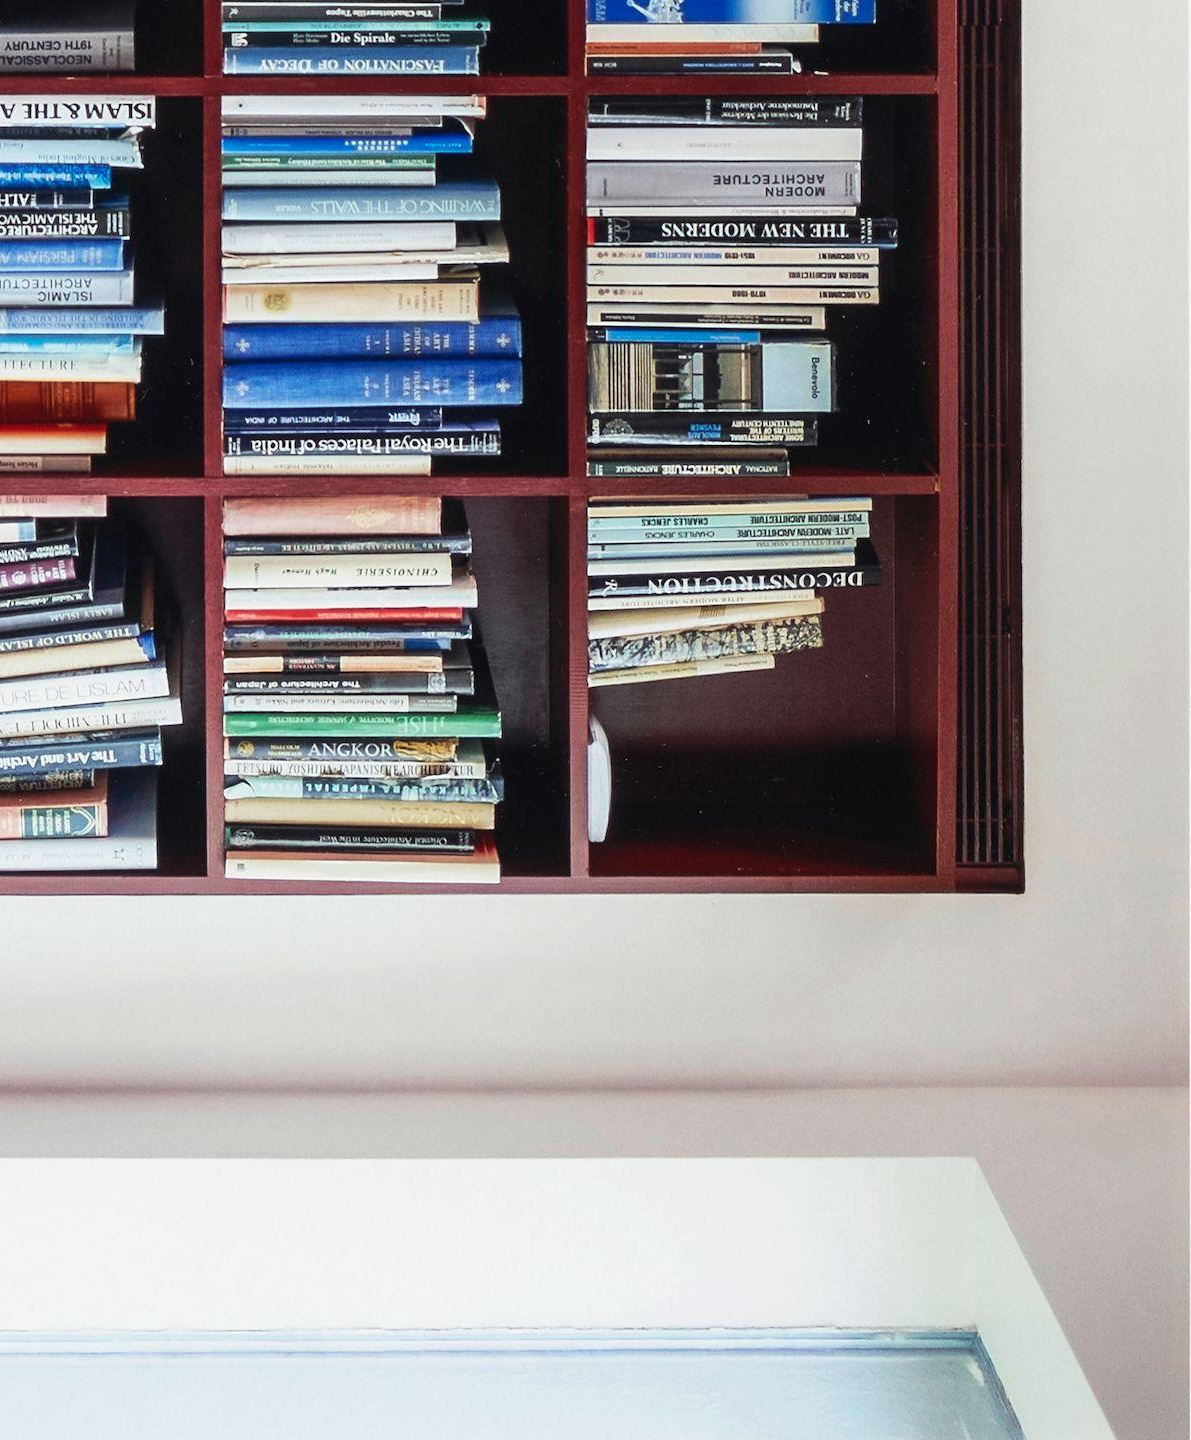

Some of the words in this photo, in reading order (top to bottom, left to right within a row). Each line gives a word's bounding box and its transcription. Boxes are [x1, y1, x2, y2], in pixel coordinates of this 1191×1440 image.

[4, 41, 61, 51] CENTURY
[65, 40, 92, 51] 19TH
[260, 59, 312, 72] DECAY
[318, 60, 338, 71] OF
[345, 60, 446, 72] FASCINATION
[23, 104, 61, 118] THE
[65, 103, 80, 118] &
[84, 102, 152, 118] ISLAM
[713, 174, 825, 186] ARCHITECTURE
[765, 187, 825, 197] MODERN
[661, 222, 756, 237] MODERNS
[761, 223, 804, 237] NEW
[808, 222, 849, 237] THE
[38, 292, 92, 301] ISLAMIC
[812, 357, 820, 399] Benevolo
[251, 440, 295, 453] India
[297, 439, 316, 453] of
[320, 438, 383, 452] Palaces
[386, 435, 430, 451] Royal
[431, 438, 464, 451] The
[751, 515, 806, 524] ARCHITECTURE
[808, 514, 862, 523] POST-MODERN
[356, 568, 438, 577] CHINOISERIE
[647, 570, 864, 596] DECONSTRUCTION
[236, 680, 266, 689] Japan
[269, 681, 278, 689] of
[281, 680, 339, 689] Architecture
[308, 742, 393, 758] ANGKOR
[41, 755, 63, 765] and
[67, 752, 88, 765] Art
[91, 751, 116, 763] The
